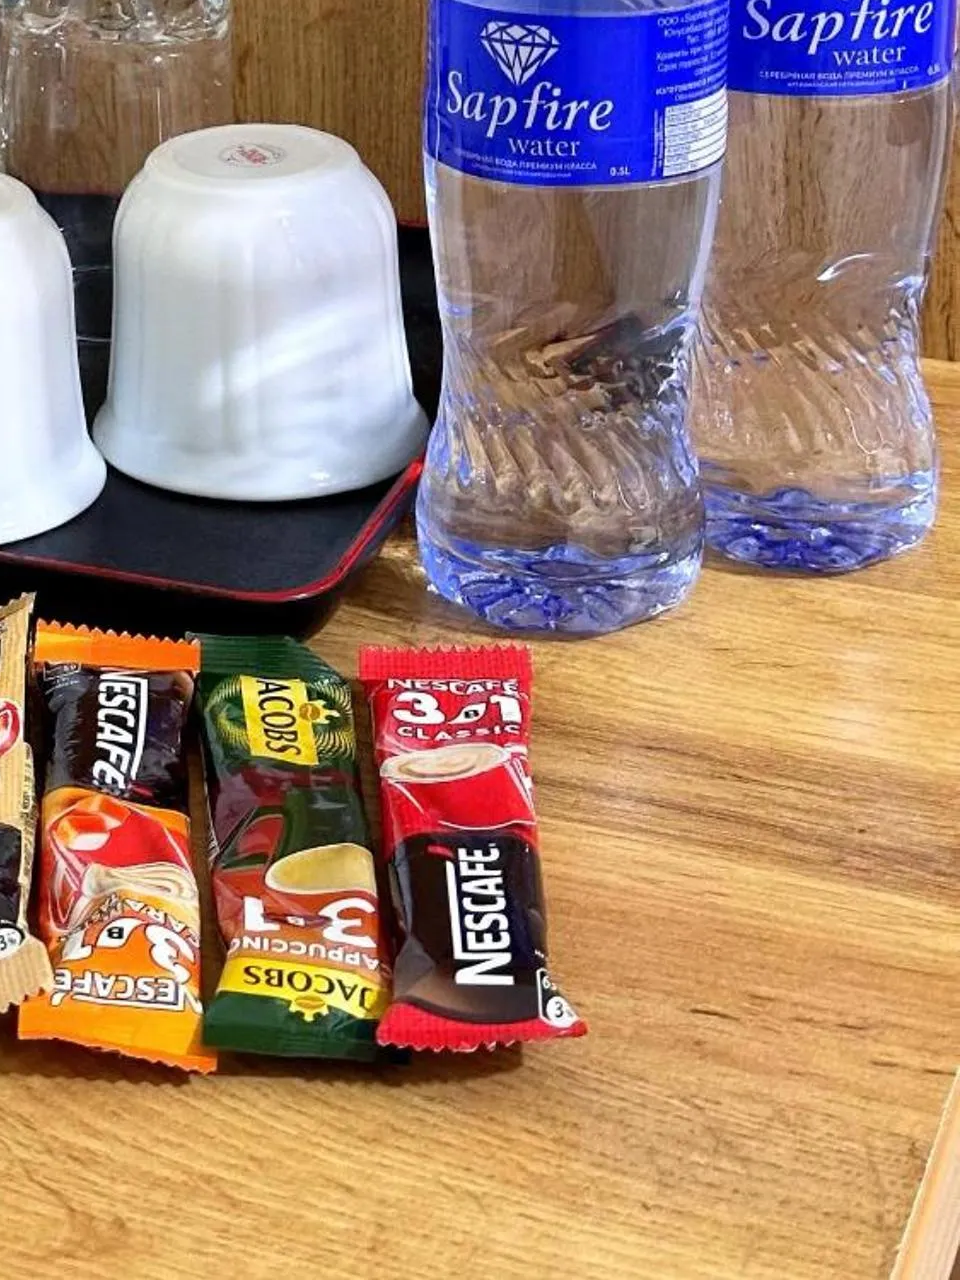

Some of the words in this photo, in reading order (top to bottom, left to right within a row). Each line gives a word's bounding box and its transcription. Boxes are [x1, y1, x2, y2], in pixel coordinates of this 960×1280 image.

[832, 45, 906, 66] water
[447, 70, 614, 138] Sapfire
[508, 137, 581, 156] water
[392, 690, 446, 725] 3
[490, 694, 522, 724] 1
[397, 724, 521, 741] CLASSIC
[241, 895, 279, 933] 1
[322, 897, 376, 949] 3
[243, 963, 375, 1012] JACOBS
